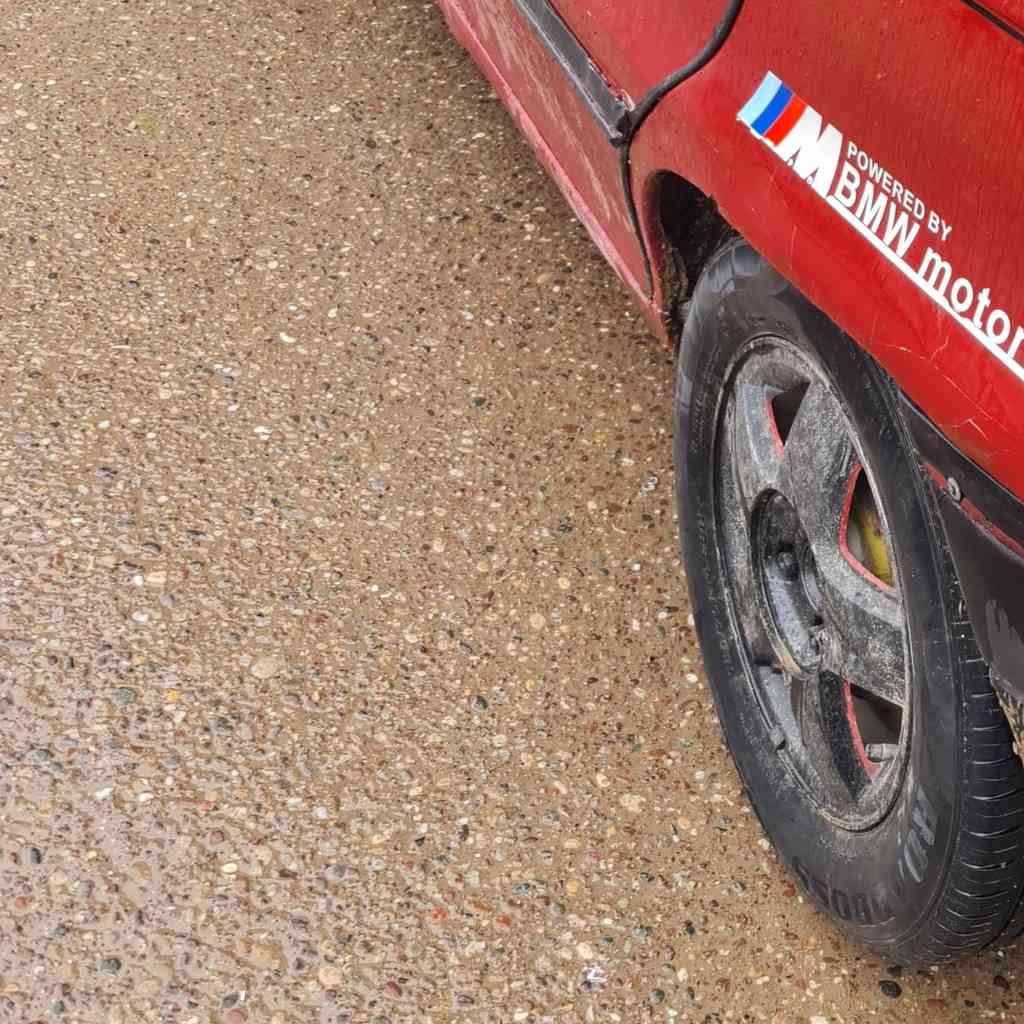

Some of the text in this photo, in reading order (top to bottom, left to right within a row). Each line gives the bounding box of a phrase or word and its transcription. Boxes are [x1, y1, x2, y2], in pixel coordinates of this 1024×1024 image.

[833, 160, 921, 259] BMW
[847, 140, 952, 242] POWERED BY
